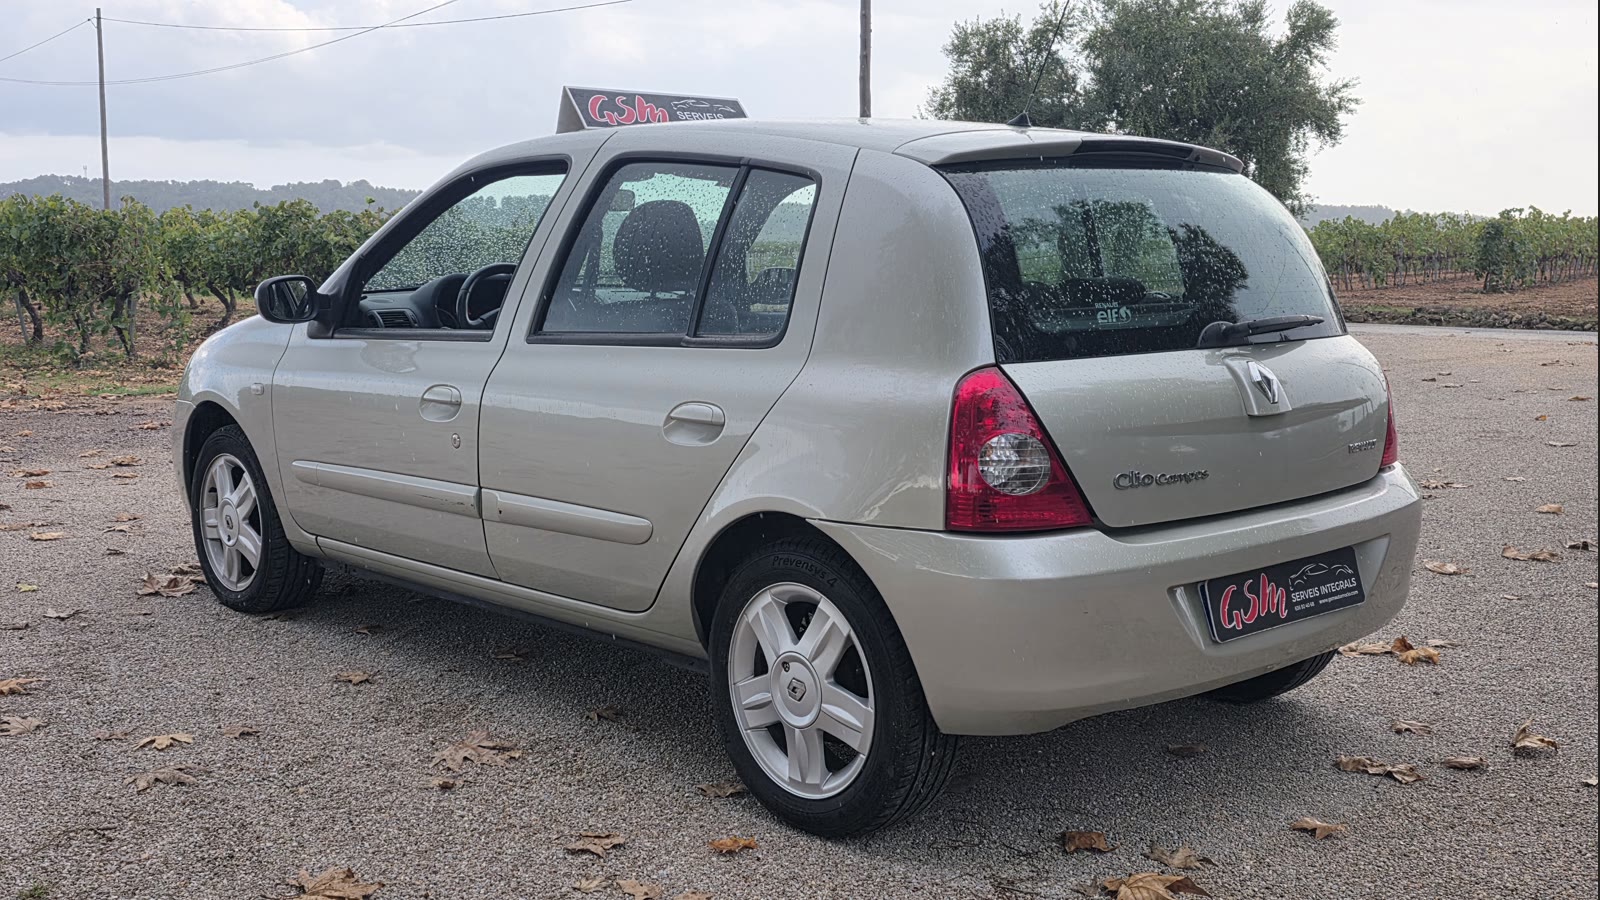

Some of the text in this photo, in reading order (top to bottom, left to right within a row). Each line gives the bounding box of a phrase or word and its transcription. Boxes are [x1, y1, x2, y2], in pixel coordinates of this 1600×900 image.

[1113, 470, 1154, 490] Clio
[772, 555, 838, 588] Prevensys 4
[1291, 577, 1357, 603] SERVEIS INTEGRALS
